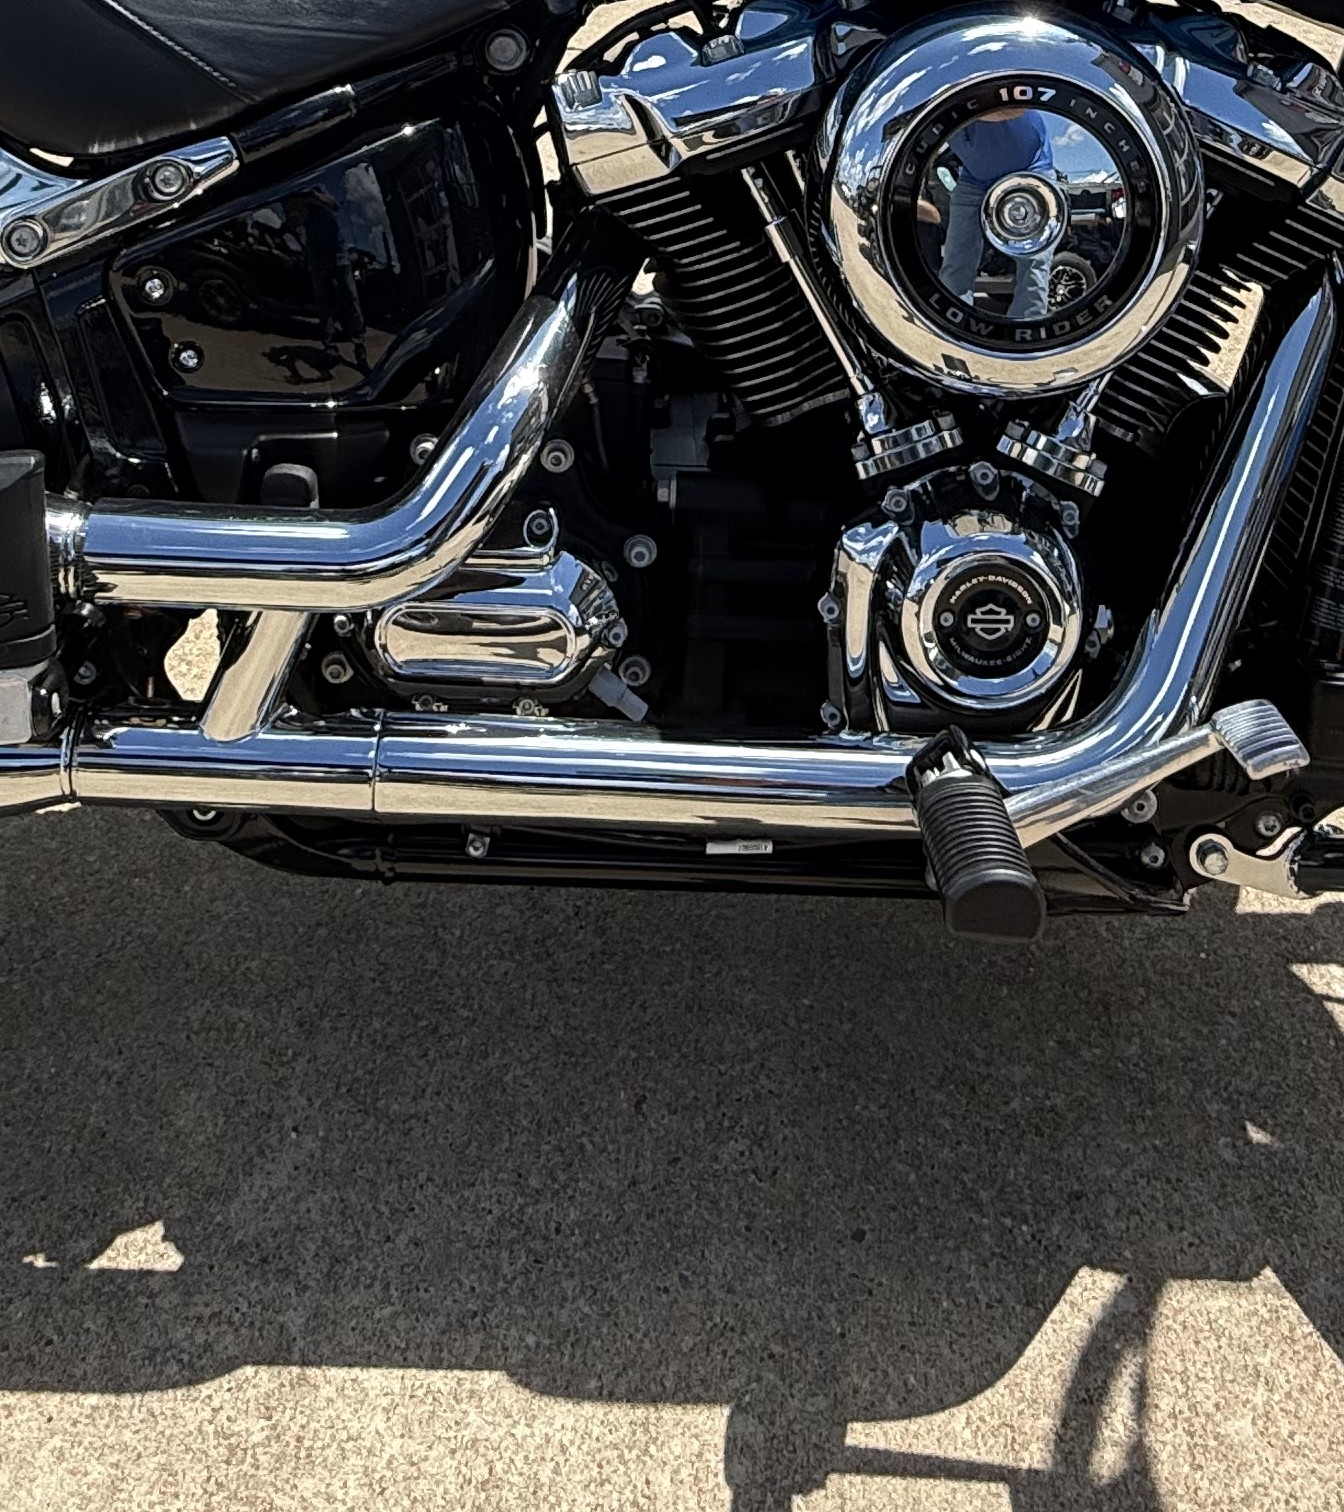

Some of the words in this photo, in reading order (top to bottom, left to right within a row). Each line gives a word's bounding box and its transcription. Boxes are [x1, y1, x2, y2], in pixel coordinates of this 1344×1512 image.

[905, 98, 979, 176] CUBIC
[998, 85, 1057, 103] 107
[1068, 98, 1149, 192] INCHE
[928, 292, 995, 335] LOW
[1014, 293, 1114, 342] RIDER
[949, 574, 1033, 605] HARLEY-DAVIDSON
